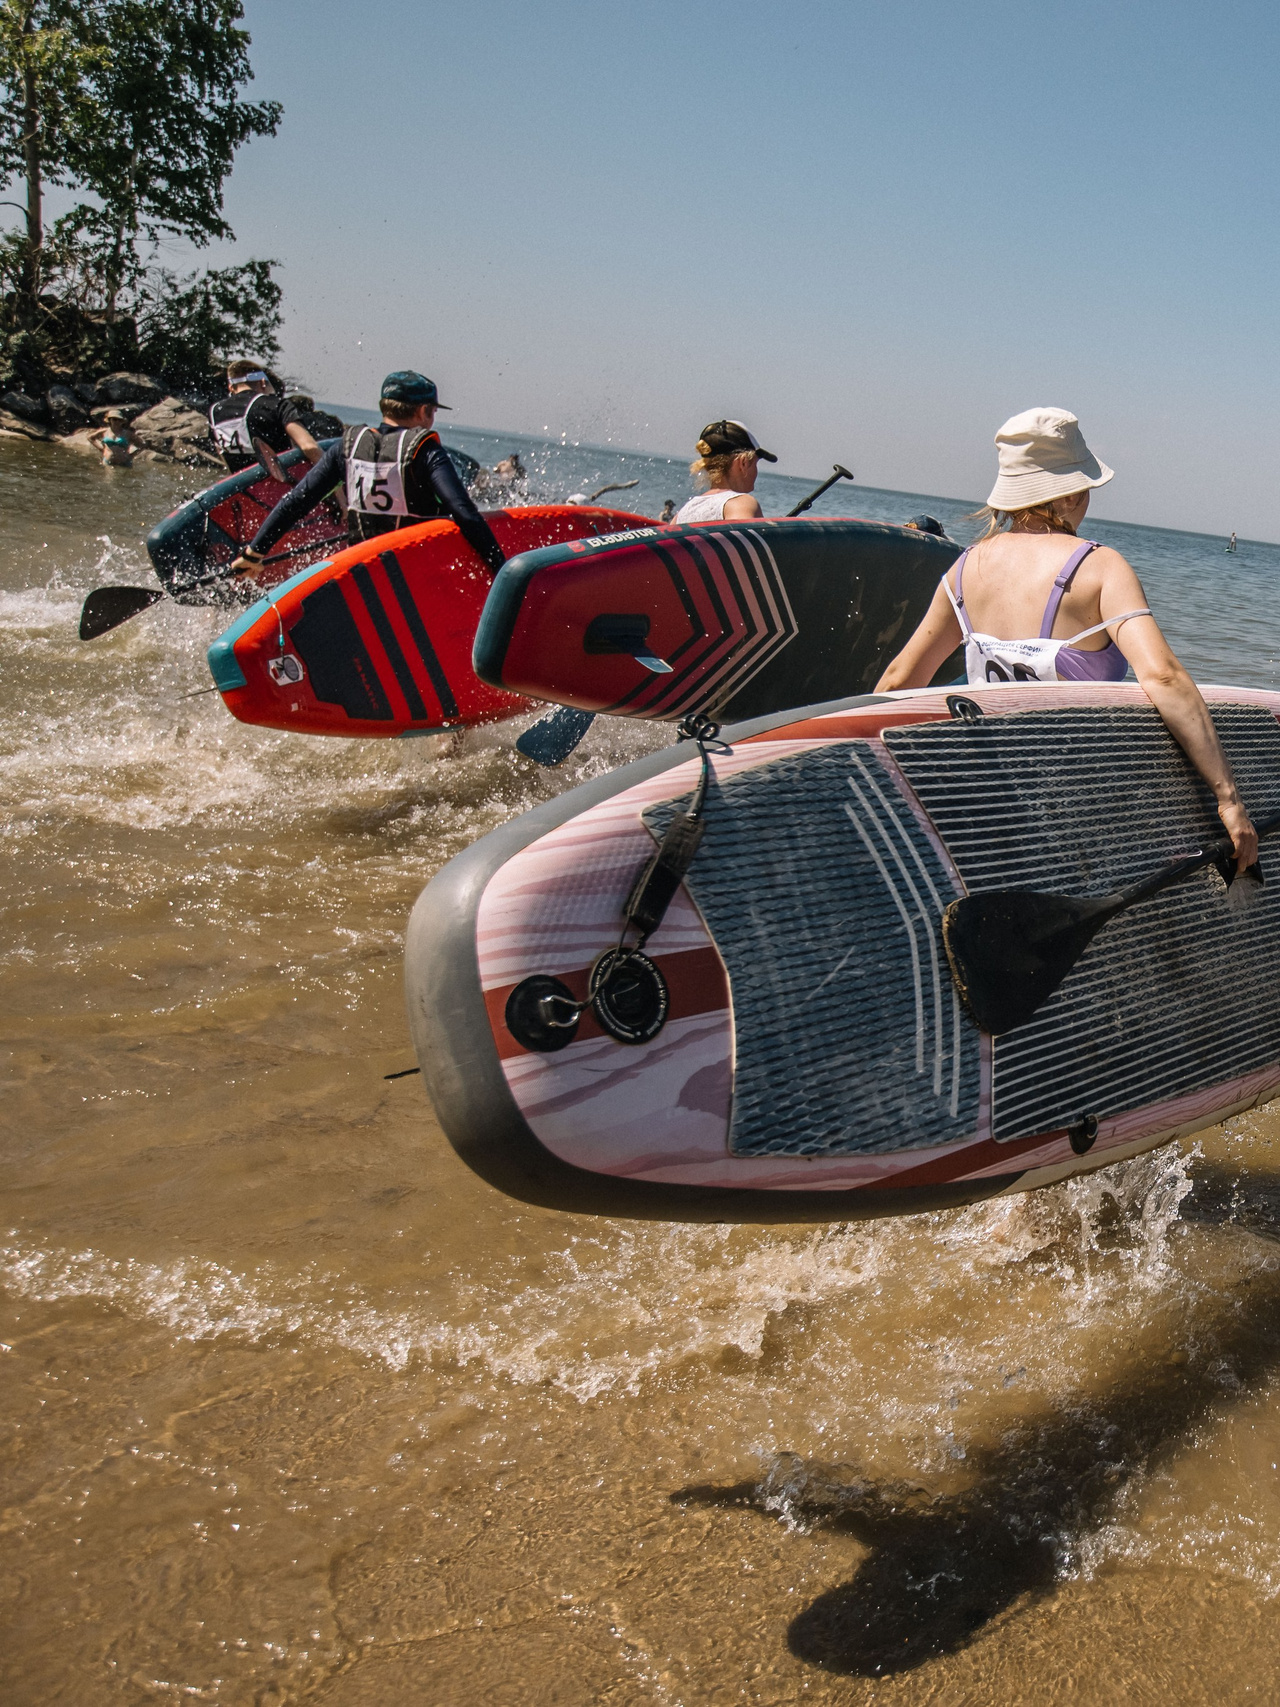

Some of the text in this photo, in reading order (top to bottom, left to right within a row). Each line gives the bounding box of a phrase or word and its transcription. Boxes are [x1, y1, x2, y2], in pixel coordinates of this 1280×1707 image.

[219, 430, 245, 454] 14
[355, 476, 394, 512] 15
[1016, 643, 1048, 653] СЕРФИН
